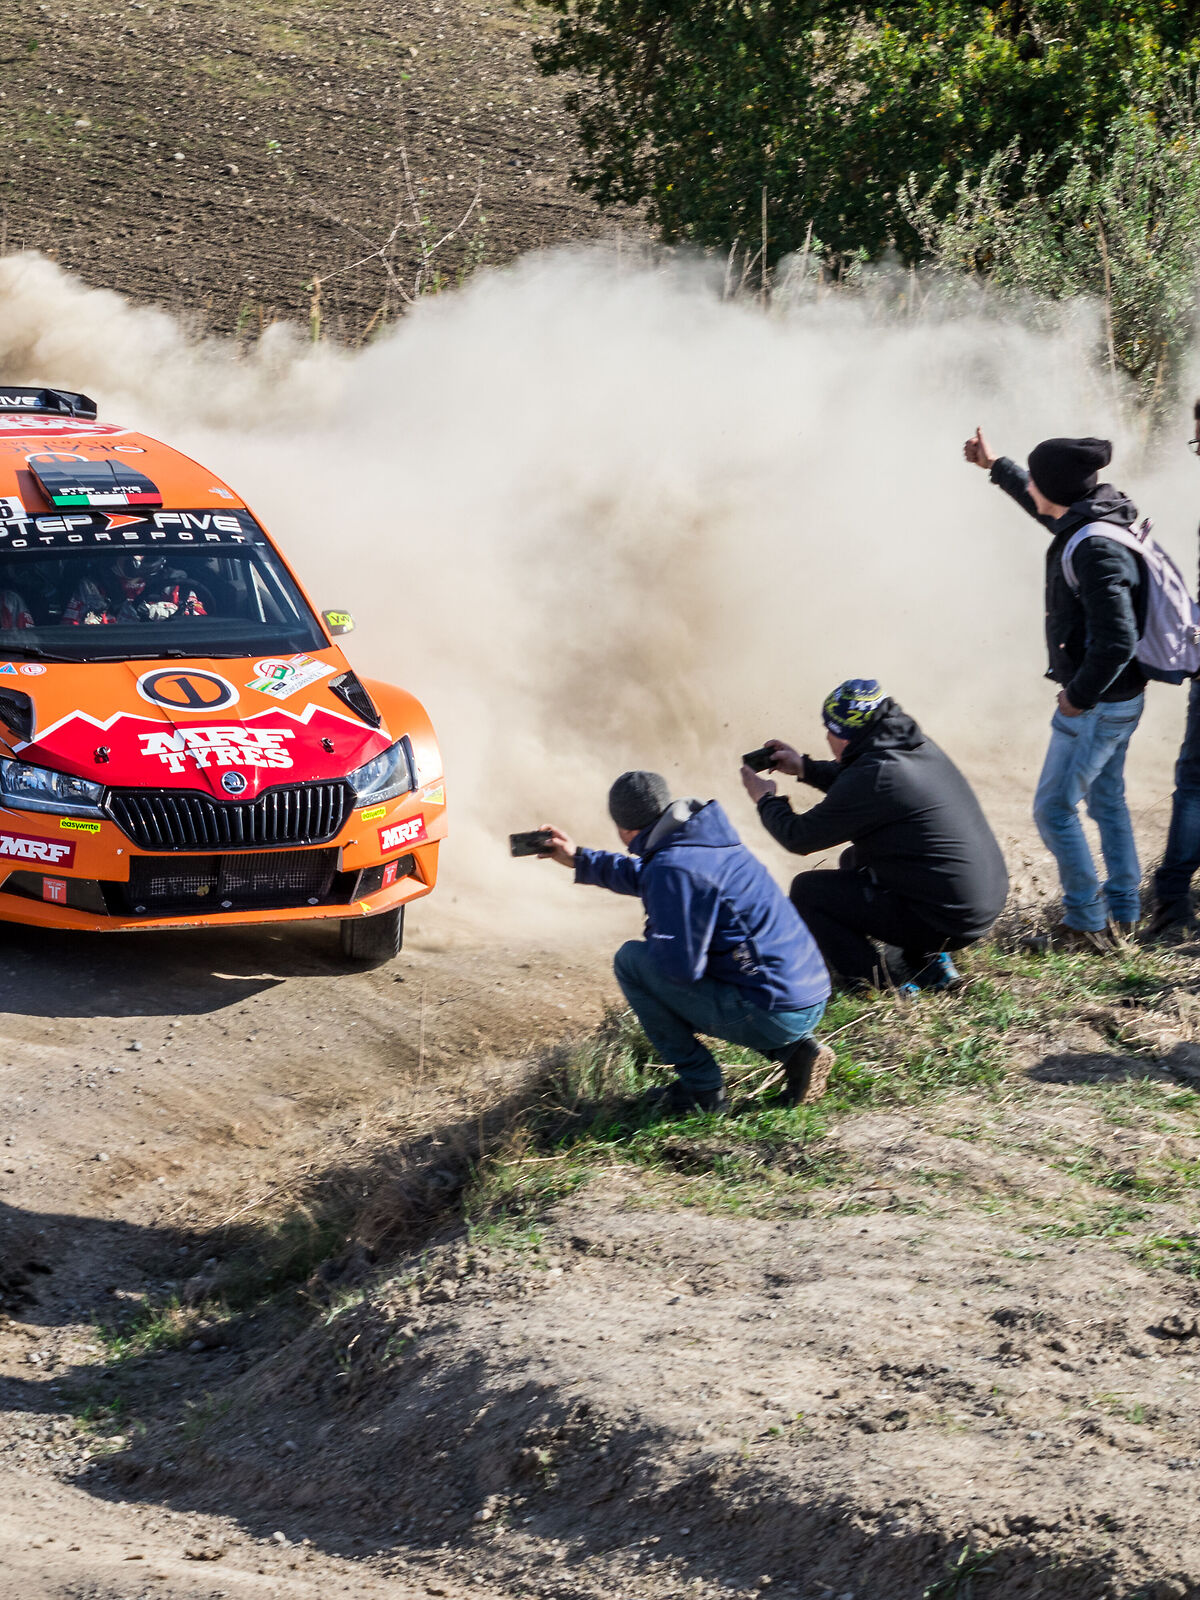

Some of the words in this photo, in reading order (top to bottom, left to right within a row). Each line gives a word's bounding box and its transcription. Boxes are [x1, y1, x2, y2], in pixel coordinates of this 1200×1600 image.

[152, 512, 243, 533] FIVE
[138, 726, 296, 756] MRF
[158, 745, 294, 774] TYRES
[61, 820, 99, 832] easywrite
[381, 818, 422, 850] MRF
[151, 876, 218, 895] STEP
